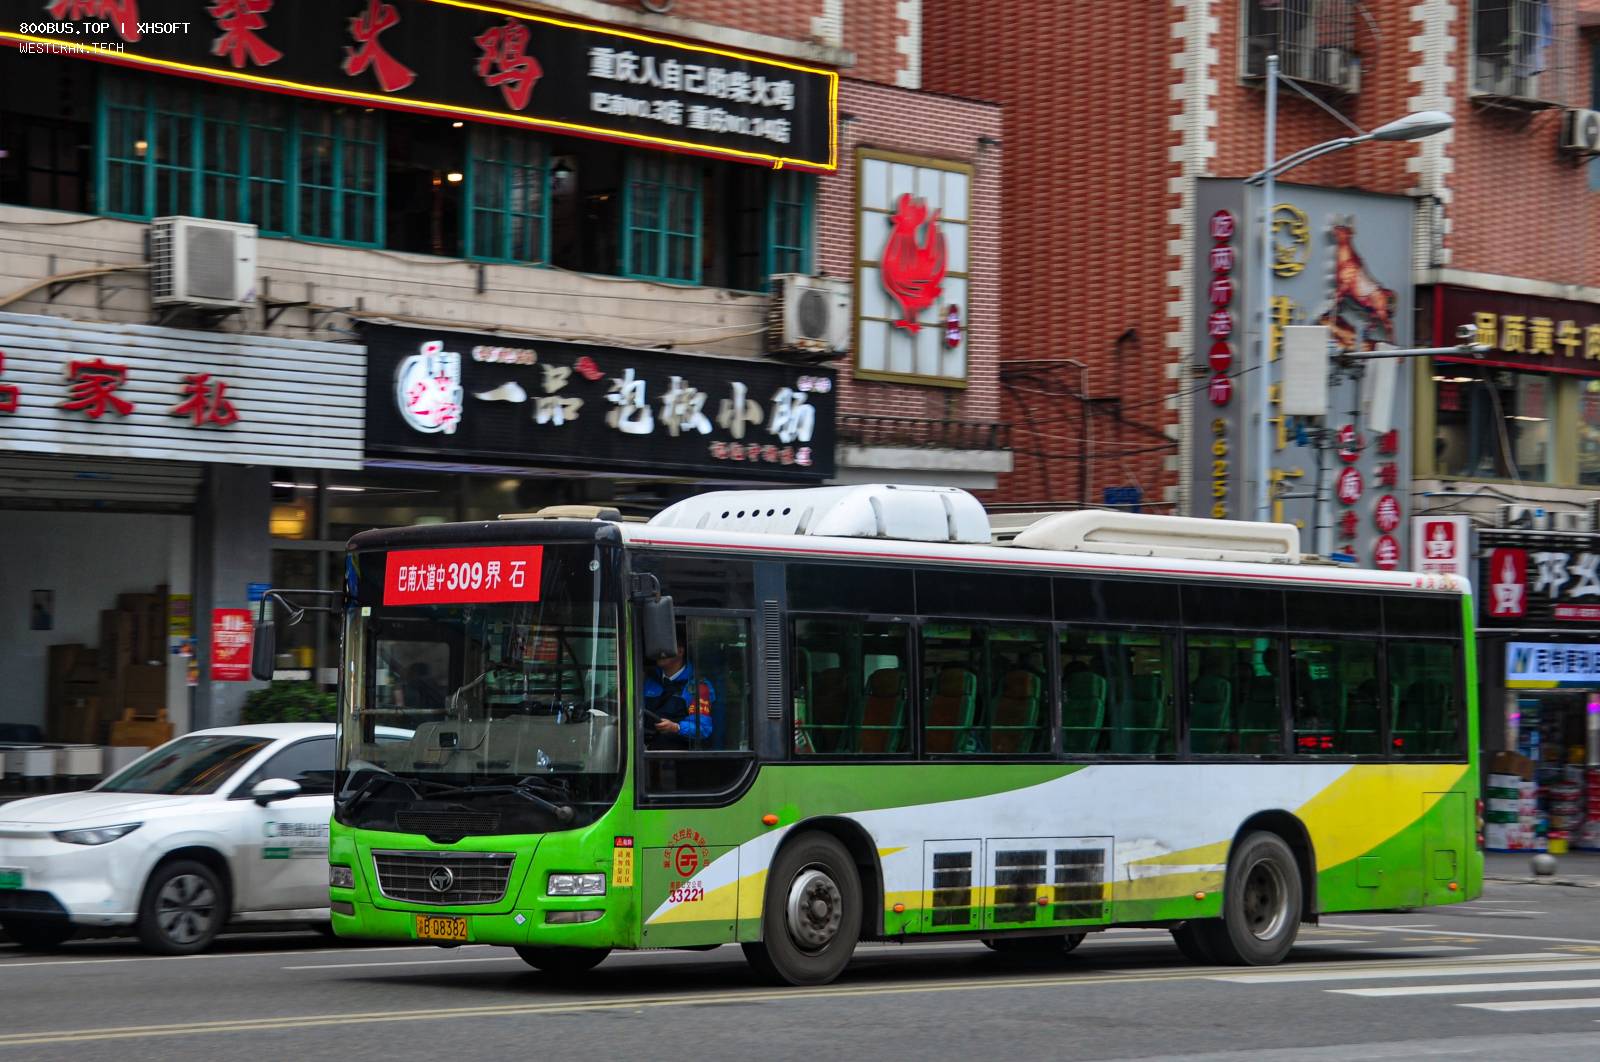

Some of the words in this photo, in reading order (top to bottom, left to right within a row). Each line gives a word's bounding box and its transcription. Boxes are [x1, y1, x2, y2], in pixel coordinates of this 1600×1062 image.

[587, 46, 795, 111] 重庆人自己的柴火鸡
[398, 564, 446, 592] 巴南大道中
[446, 561, 483, 591] 309
[485, 560, 527, 590] 界石
[669, 888, 705, 903] 33221
